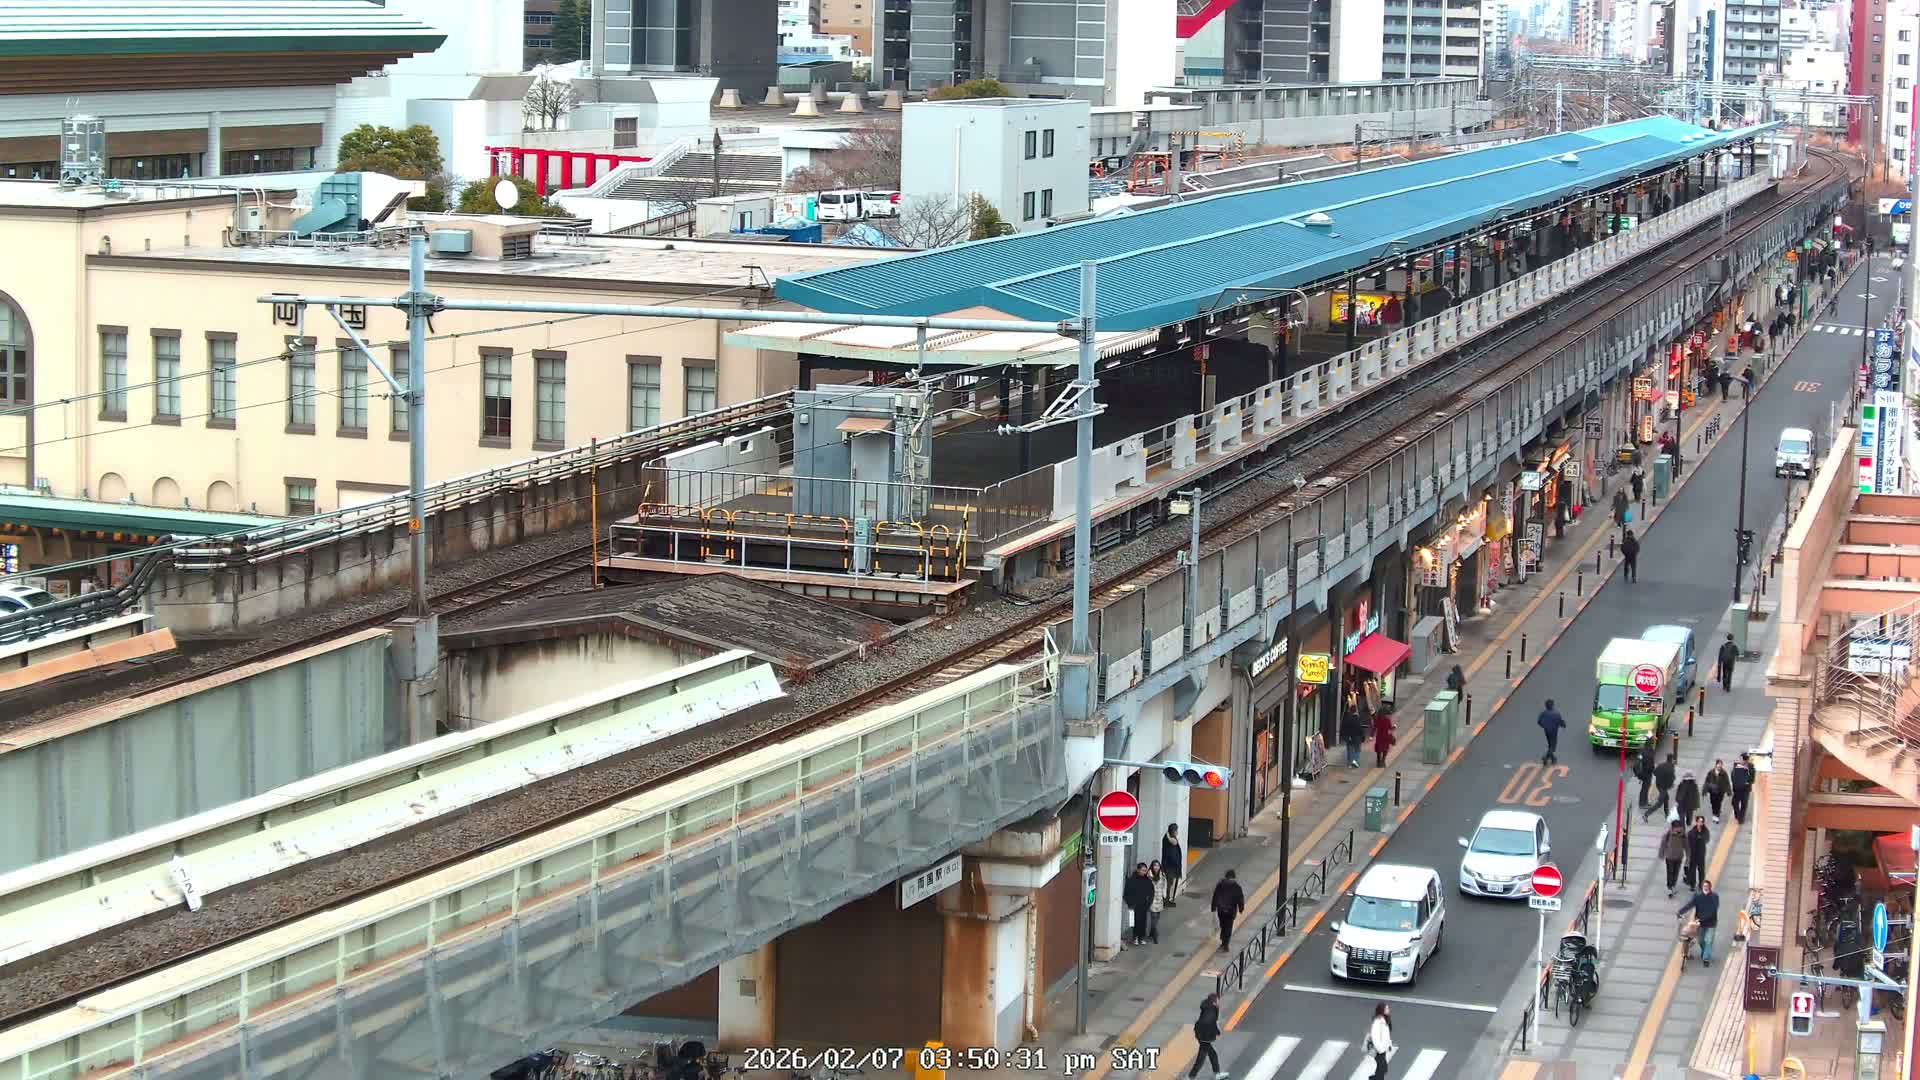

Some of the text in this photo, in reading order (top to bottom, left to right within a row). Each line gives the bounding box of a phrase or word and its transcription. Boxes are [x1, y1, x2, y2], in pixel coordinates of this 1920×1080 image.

[1879, 332, 1891, 342] 2F
[1875, 344, 1892, 391] カラオ
[1252, 651, 1270, 678] BECK'S
[1270, 636, 1288, 663] COFFEE
